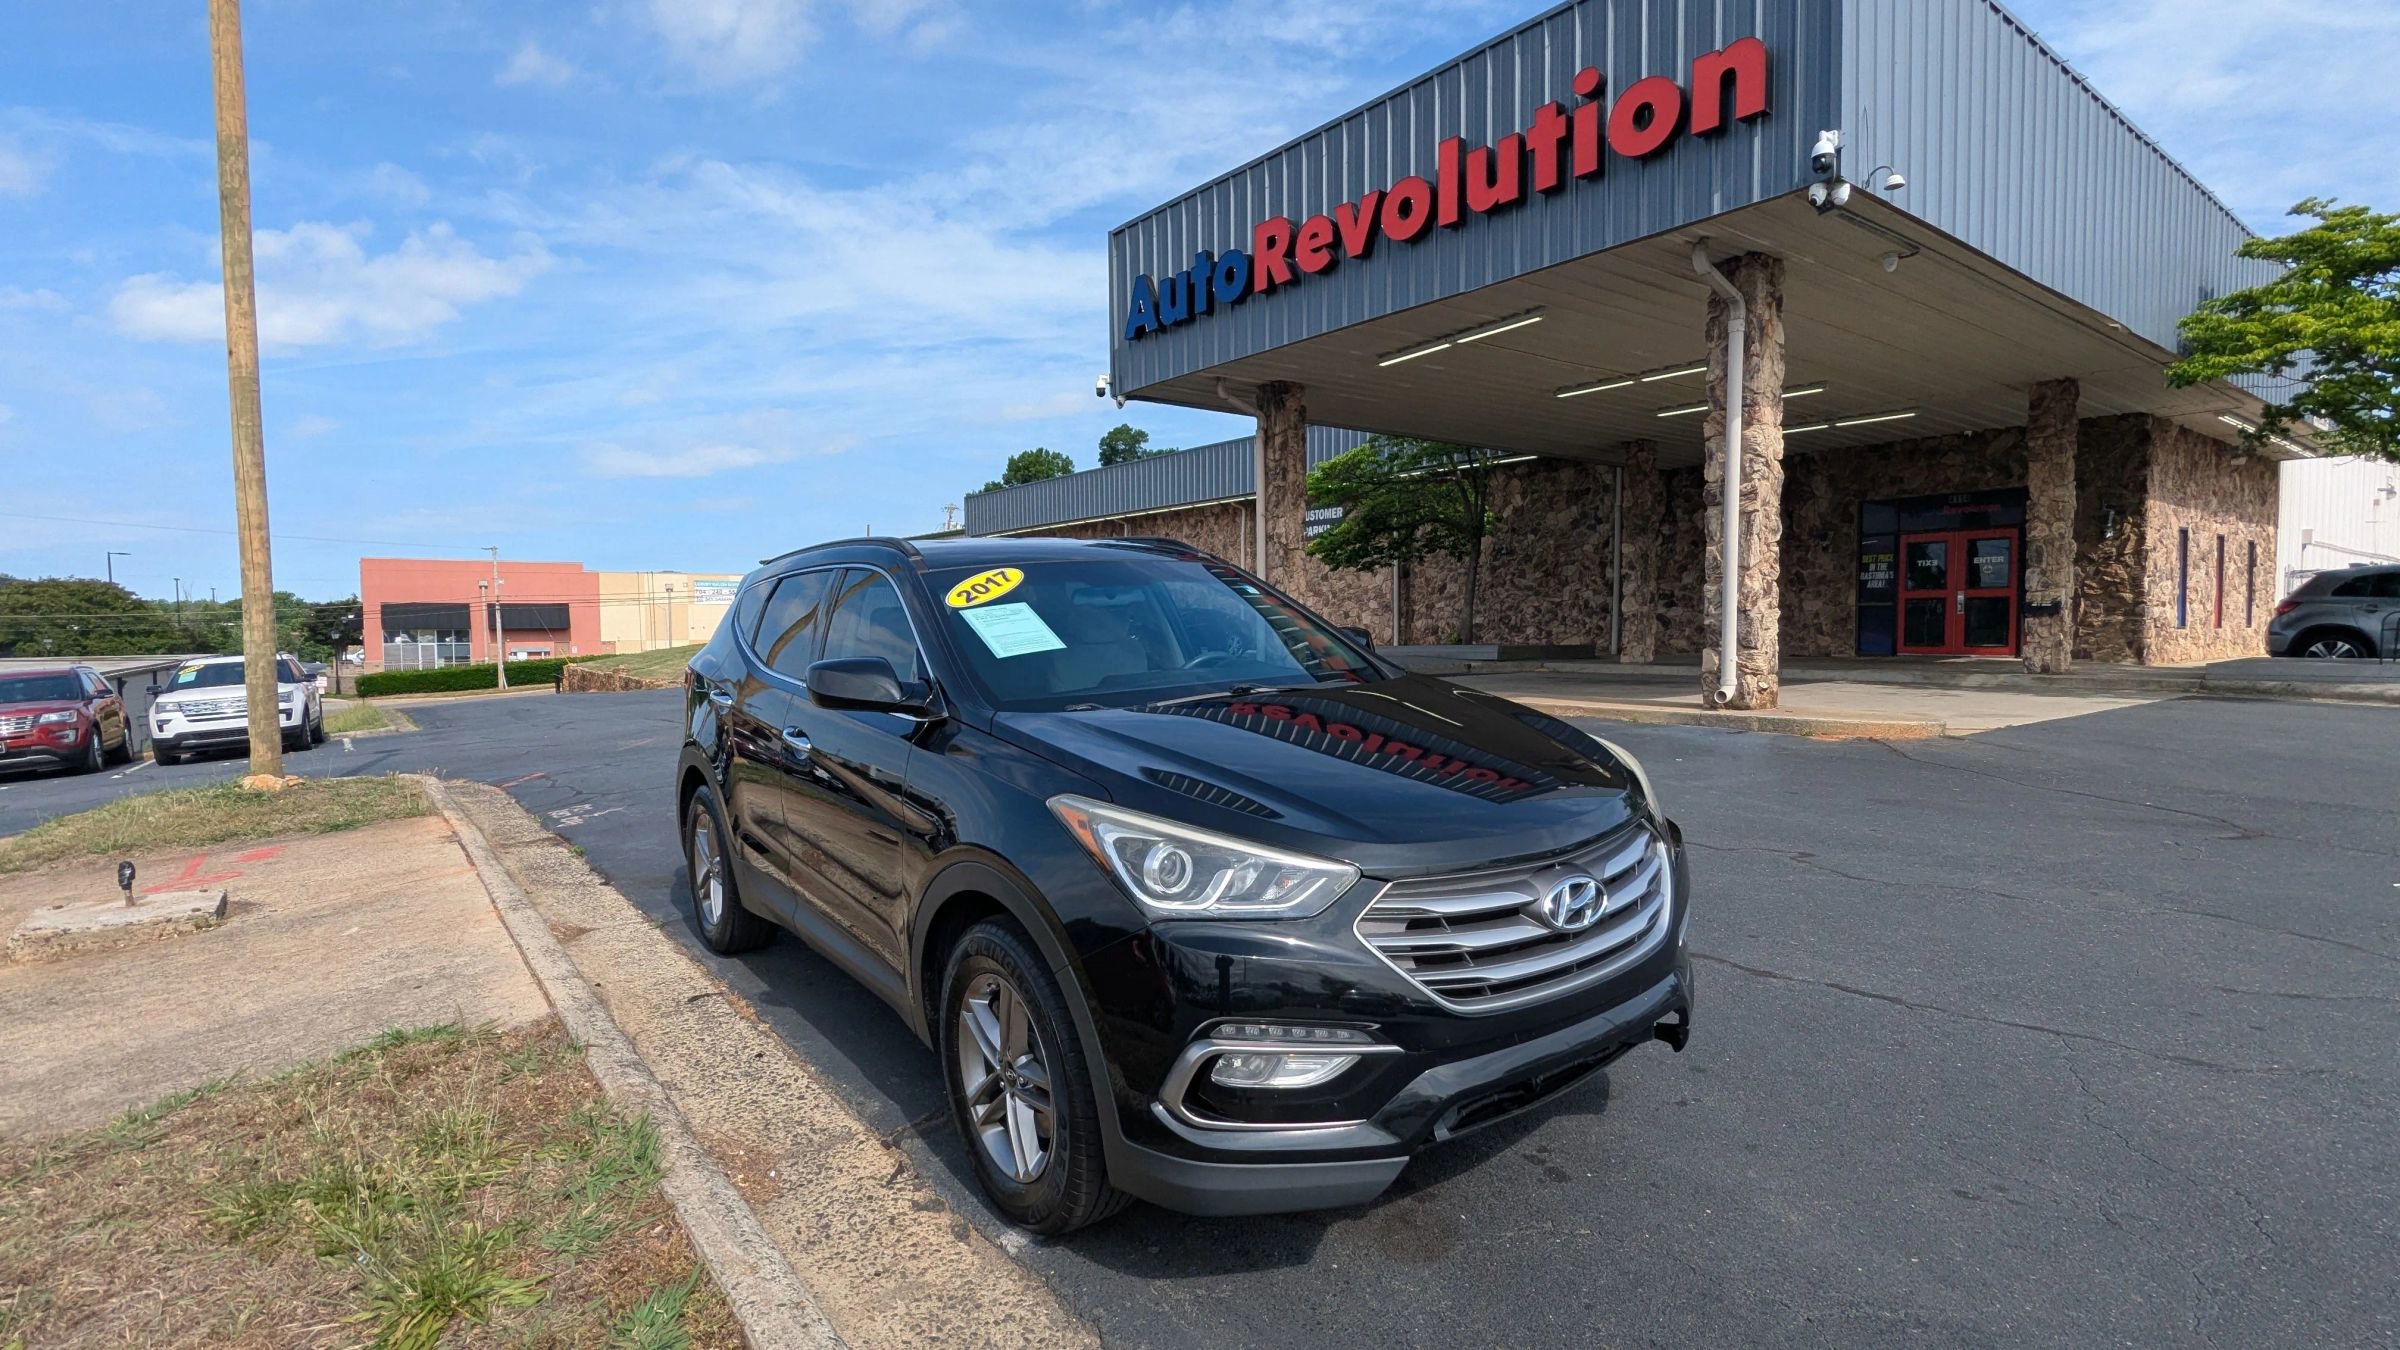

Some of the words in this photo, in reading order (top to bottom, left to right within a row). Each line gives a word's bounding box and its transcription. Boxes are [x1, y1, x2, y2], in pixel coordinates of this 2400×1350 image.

[1305, 507, 1343, 521] USTOMER
[1303, 524, 1331, 539] PARKI
[1973, 556, 2004, 564] ENTER
[957, 570, 1012, 604] 2017
